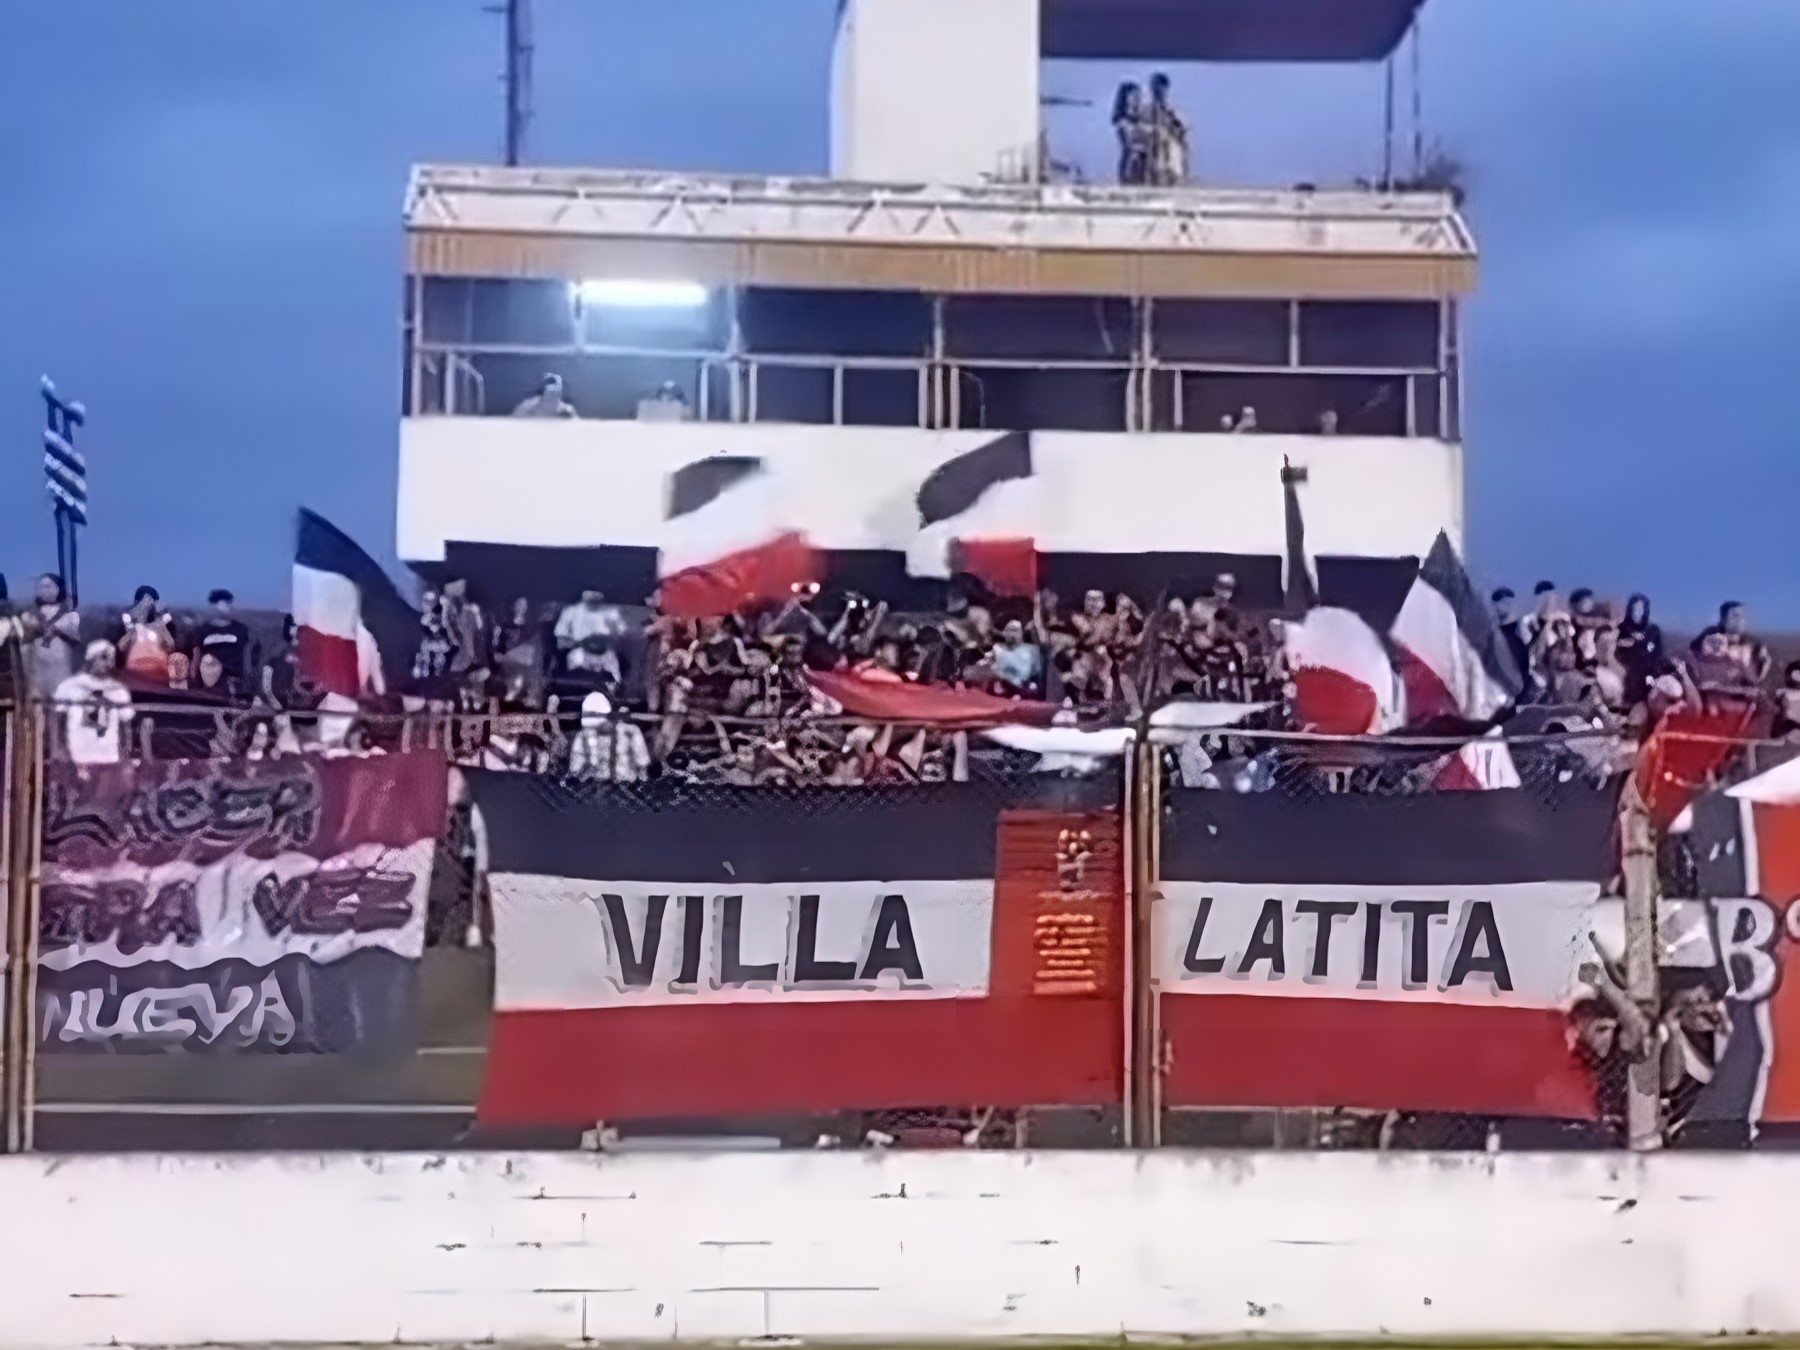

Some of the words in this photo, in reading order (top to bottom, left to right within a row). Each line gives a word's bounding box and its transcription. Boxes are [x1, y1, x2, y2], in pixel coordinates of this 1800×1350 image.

[600, 894, 928, 989] VILLA
[1180, 897, 1514, 994] LATITA
[42, 969, 297, 1047] NUEVA
